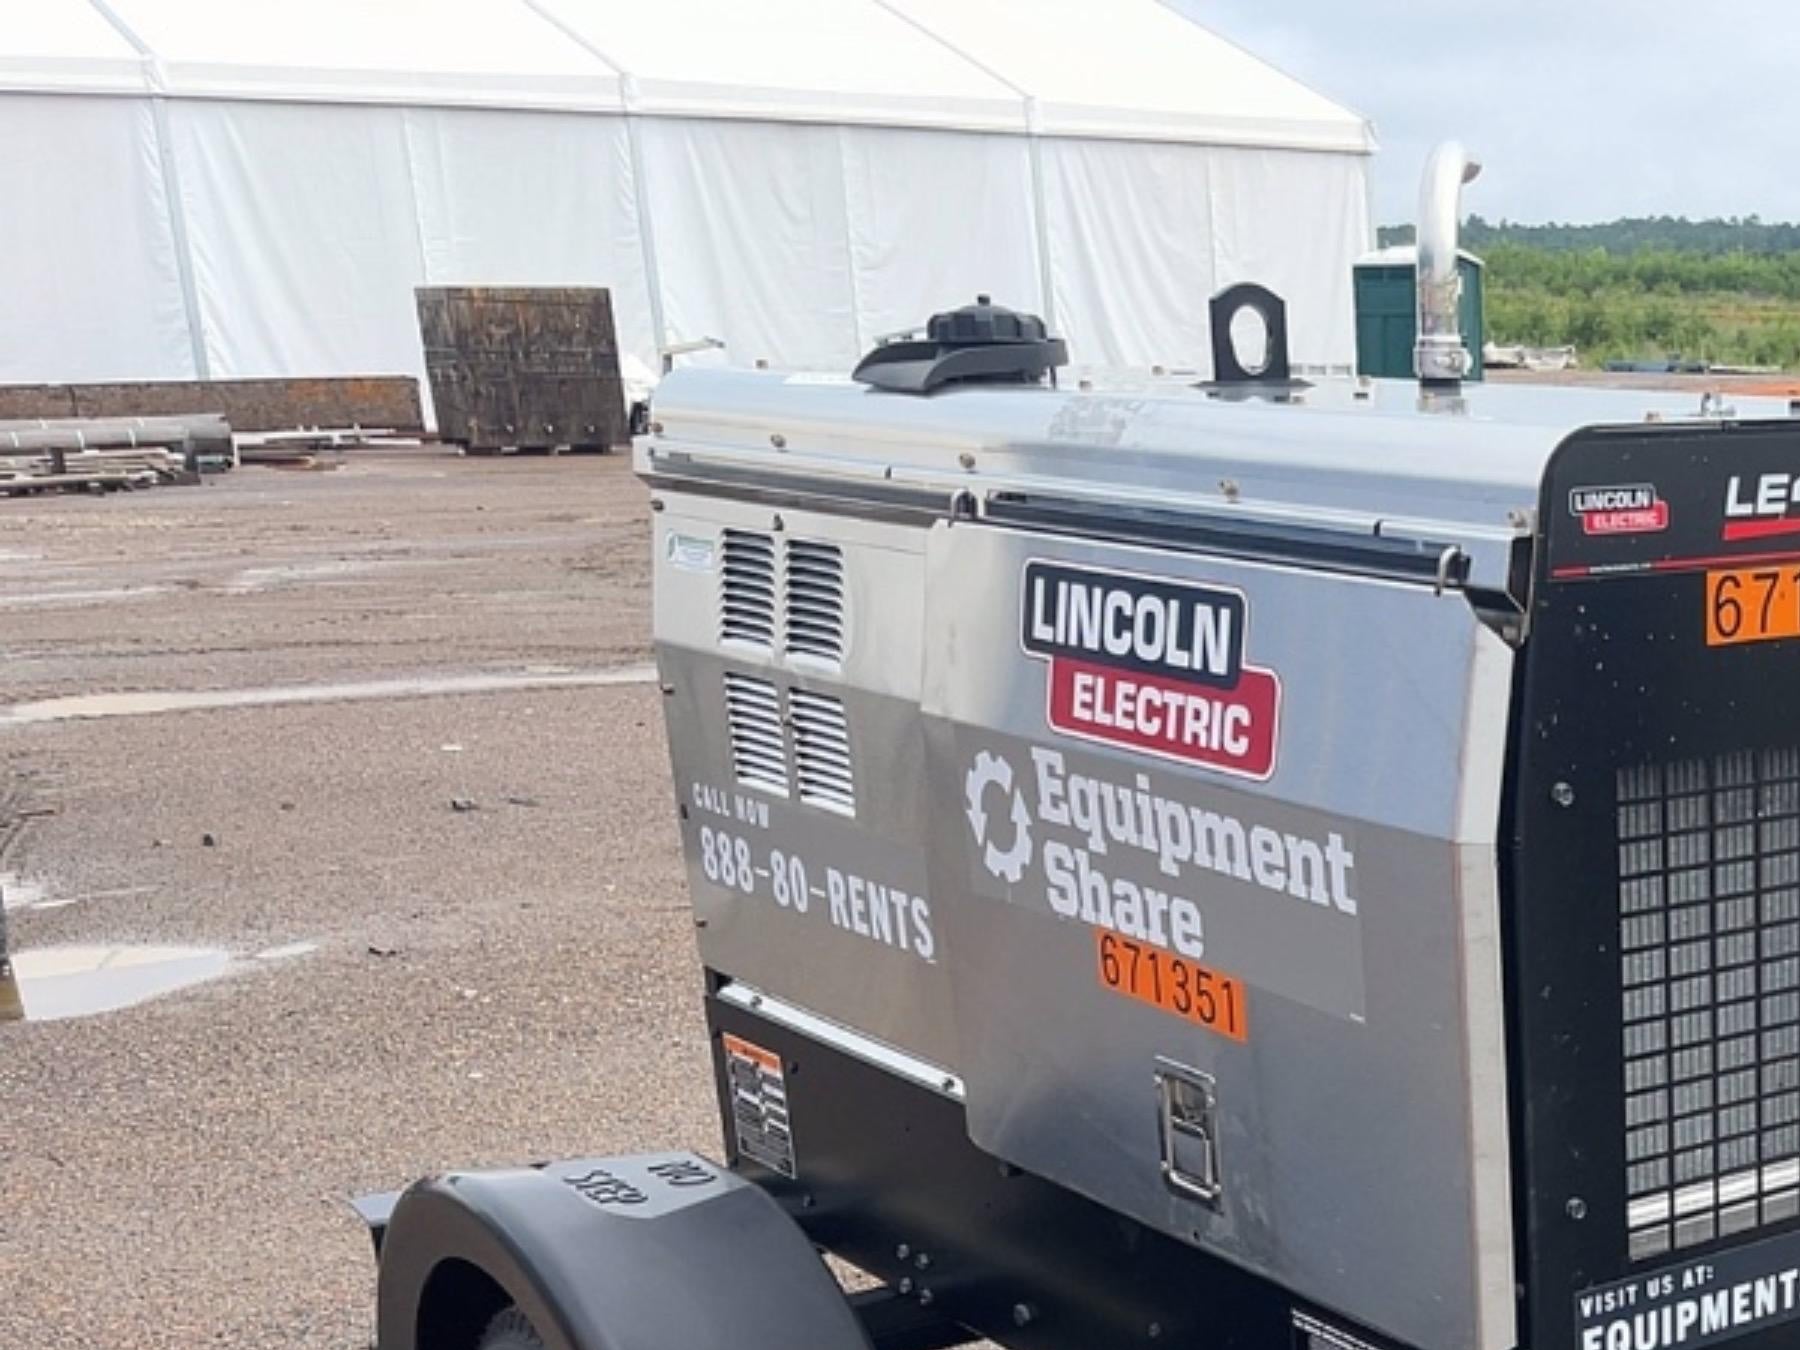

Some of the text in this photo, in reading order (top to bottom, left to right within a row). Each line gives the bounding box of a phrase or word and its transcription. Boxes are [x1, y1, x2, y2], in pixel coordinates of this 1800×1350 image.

[1575, 491, 1651, 510] LINCOLN
[1032, 576, 1231, 676] LINCOLN
[1072, 673, 1252, 756] ELECTRIC
[692, 782, 769, 828] CALL NOW
[1031, 745, 1357, 915] Equipment
[701, 826, 935, 959] 888-80-RENTS
[1043, 840, 1204, 958] Share
[1101, 934, 1233, 1033] 671351
[1580, 1266, 1714, 1318] VISIT US AT:
